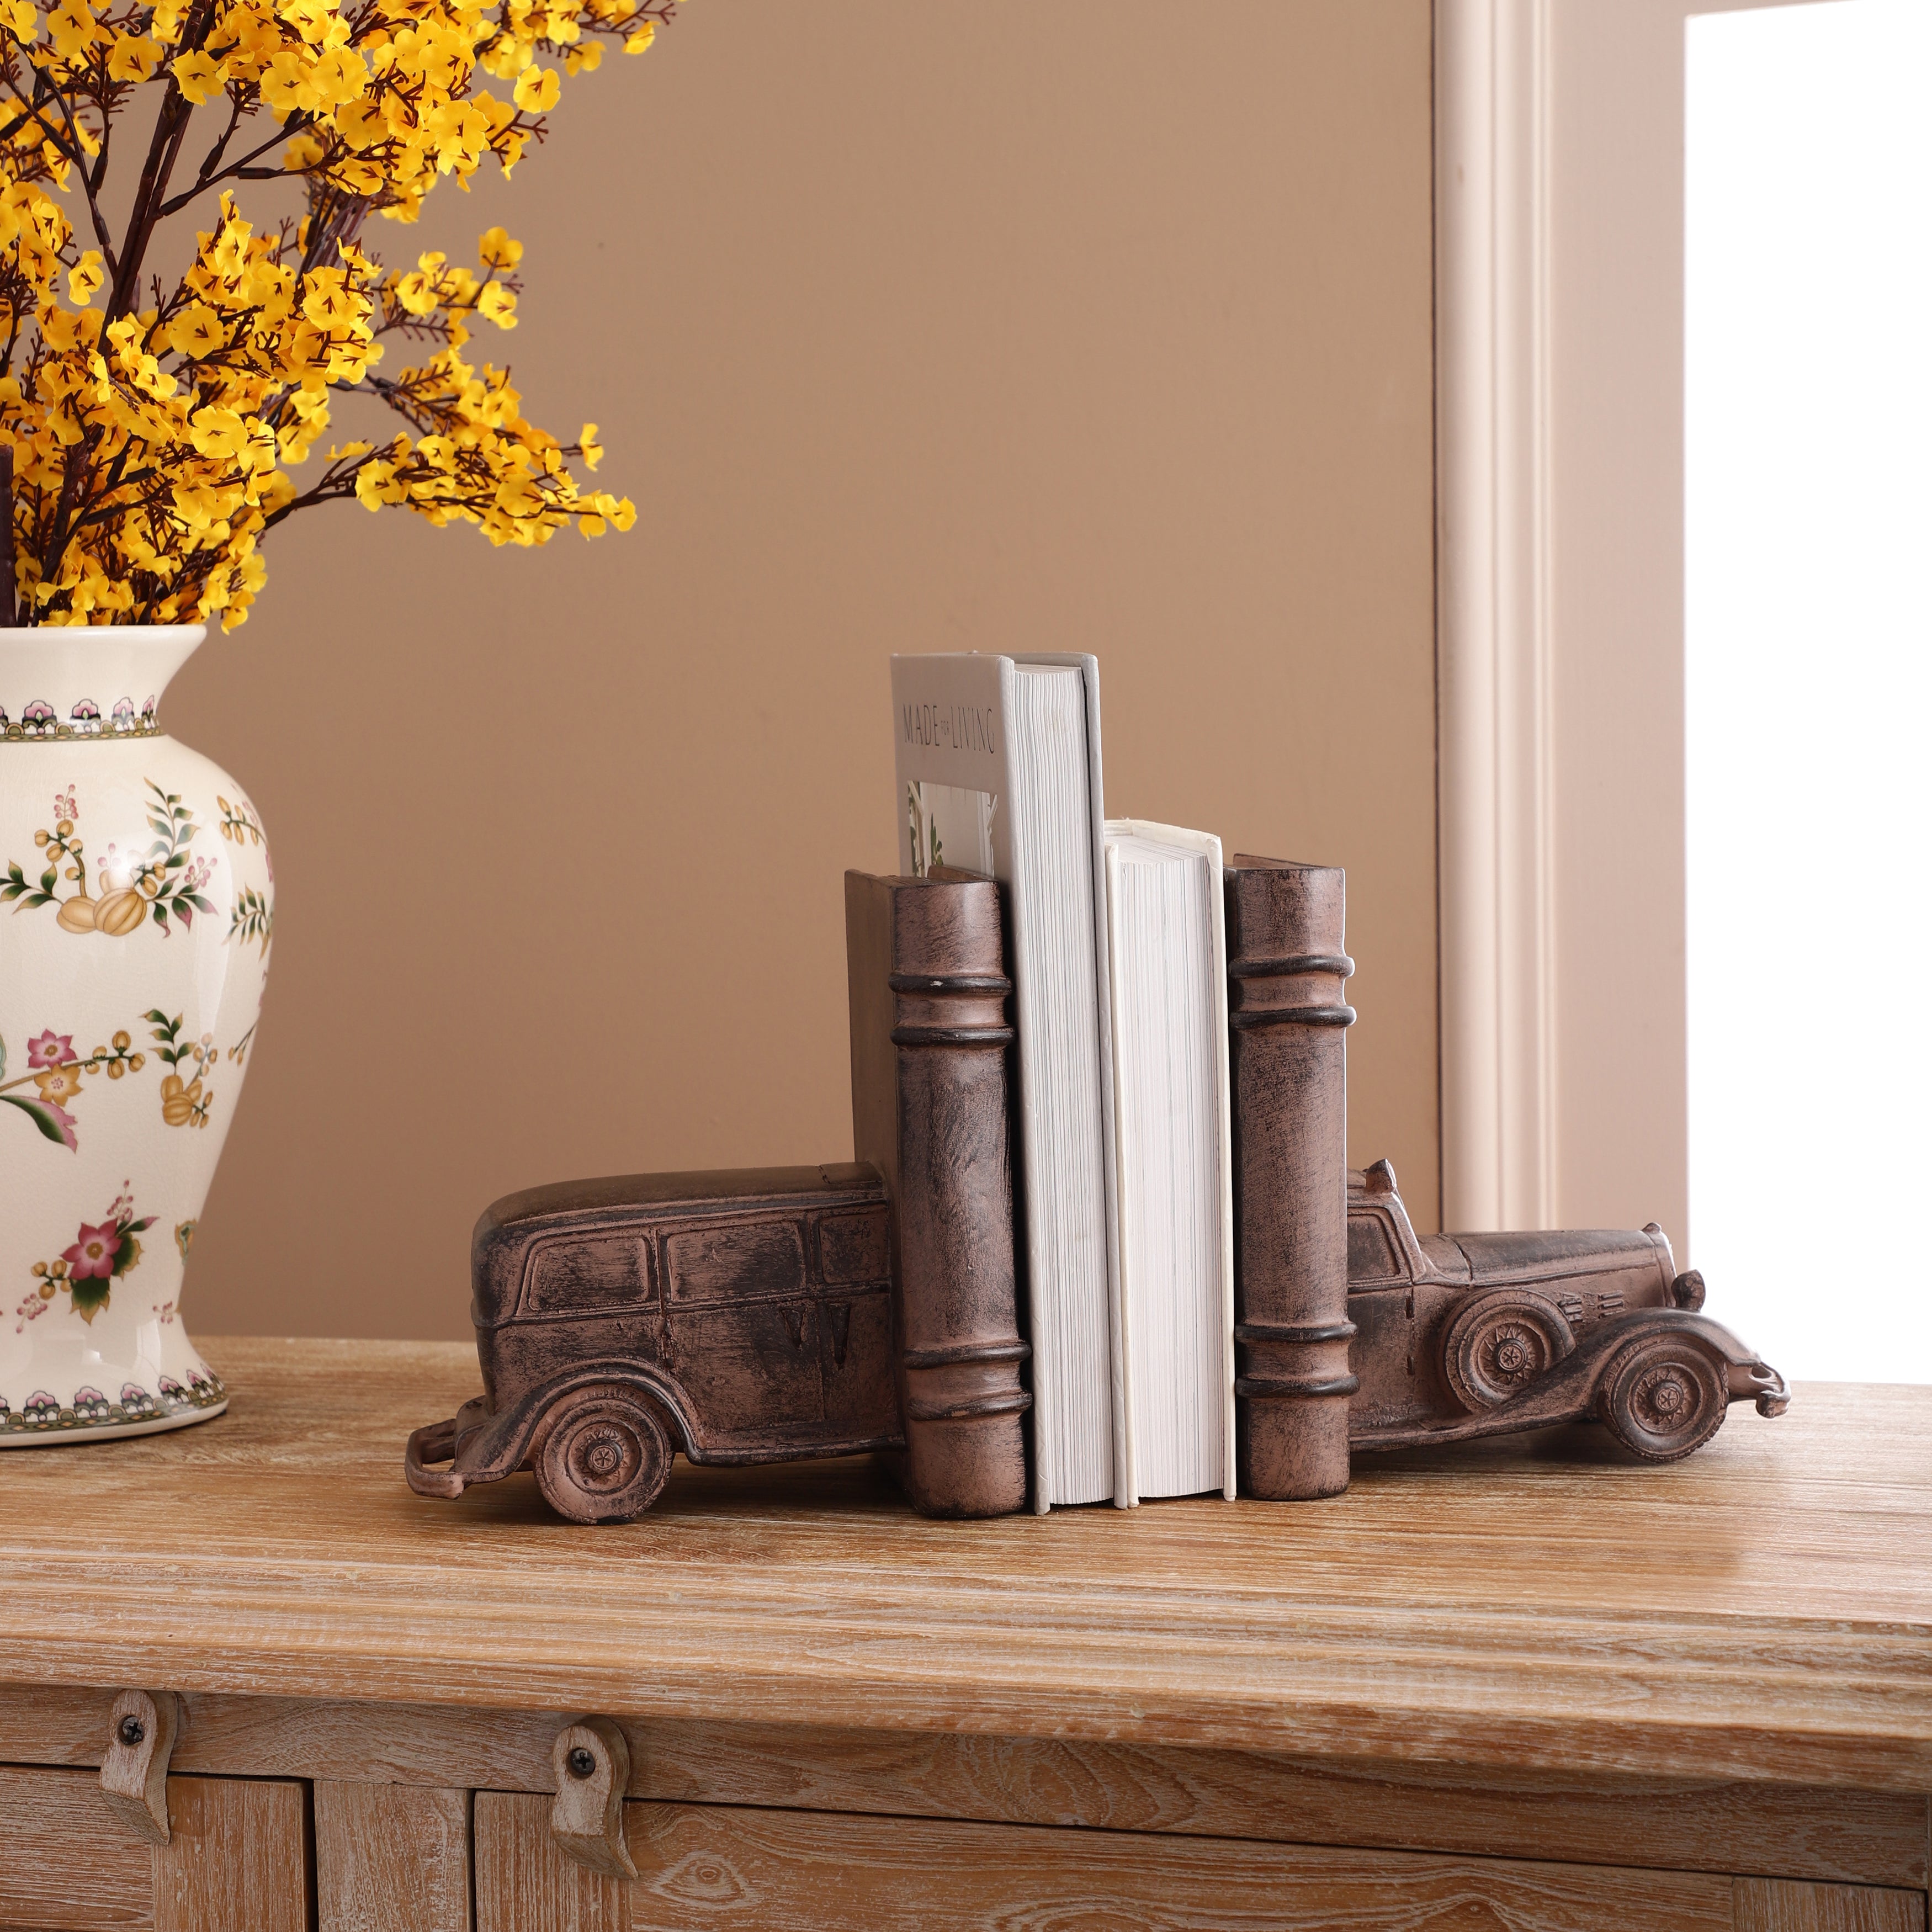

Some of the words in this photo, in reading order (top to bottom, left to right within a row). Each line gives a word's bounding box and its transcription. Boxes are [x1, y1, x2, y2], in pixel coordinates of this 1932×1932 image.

[904, 703, 940, 746] MADE
[941, 720, 949, 736] FOR
[951, 706, 995, 754] LIVING
